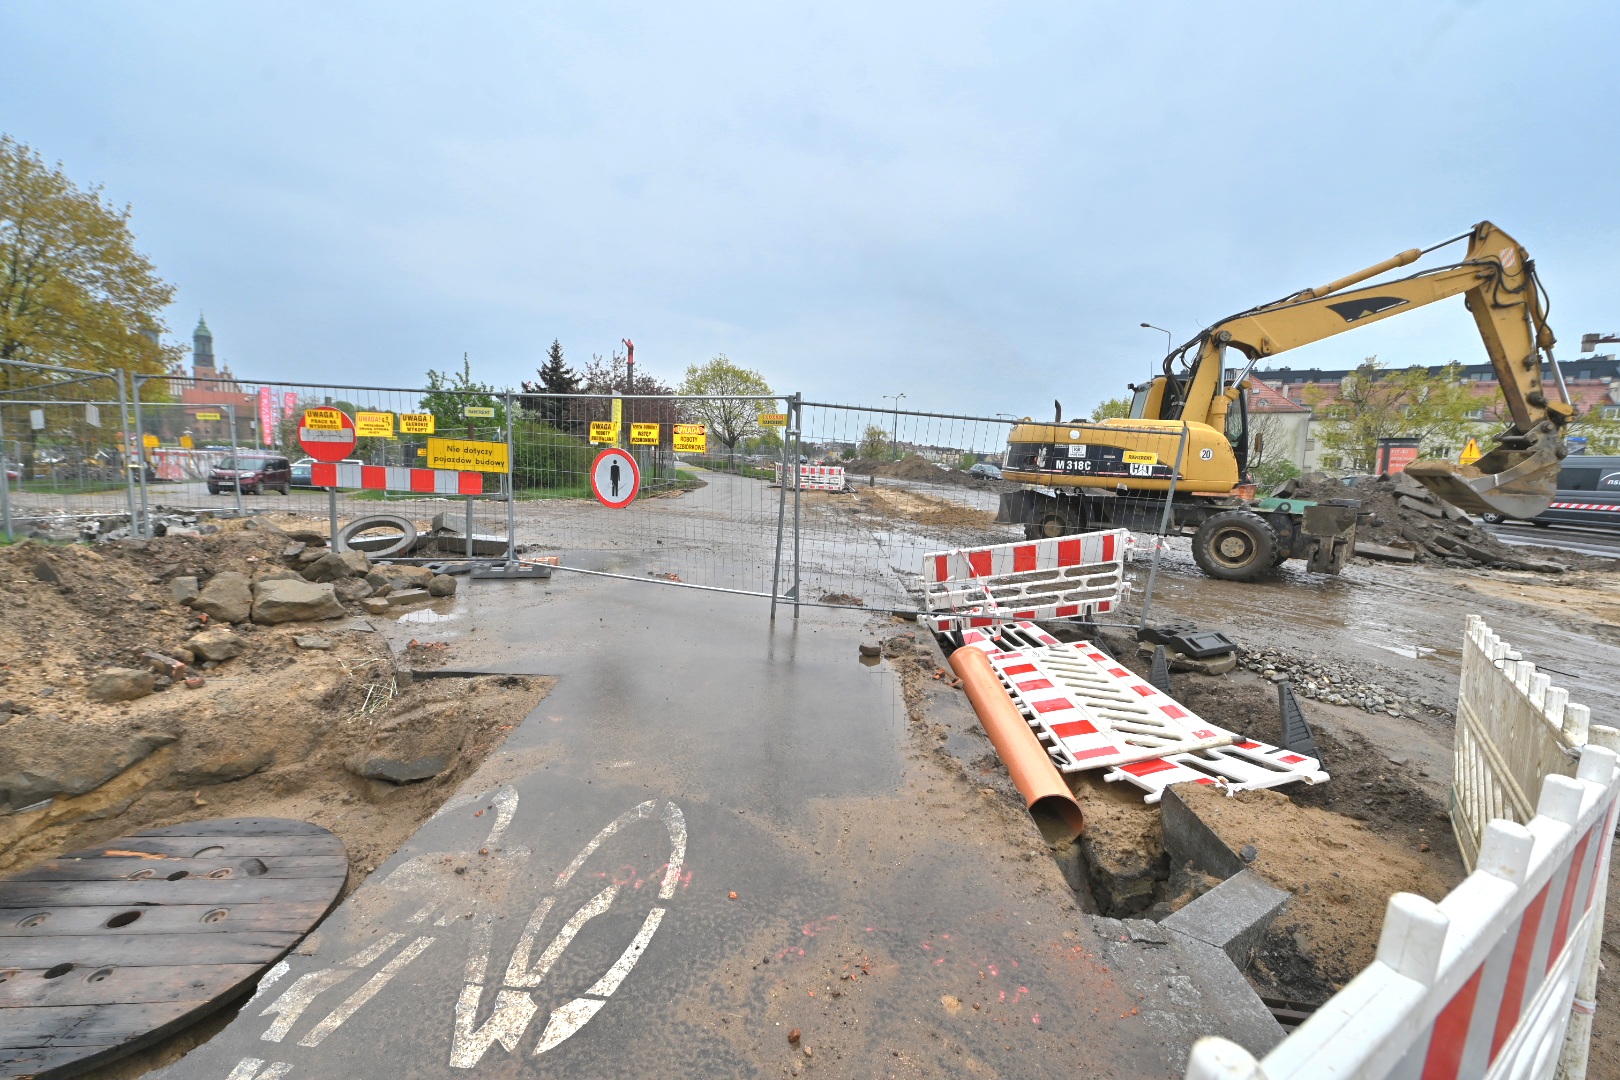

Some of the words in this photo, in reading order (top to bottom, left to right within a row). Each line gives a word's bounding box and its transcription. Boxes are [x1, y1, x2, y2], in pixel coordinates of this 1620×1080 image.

[464, 447, 493, 456] dotyczy
[1202, 450, 1211, 459] 20
[476, 458, 504, 467] budowy
[1056, 460, 1065, 469] M
[1067, 460, 1091, 470] 318C
[1130, 463, 1152, 476] CAT
